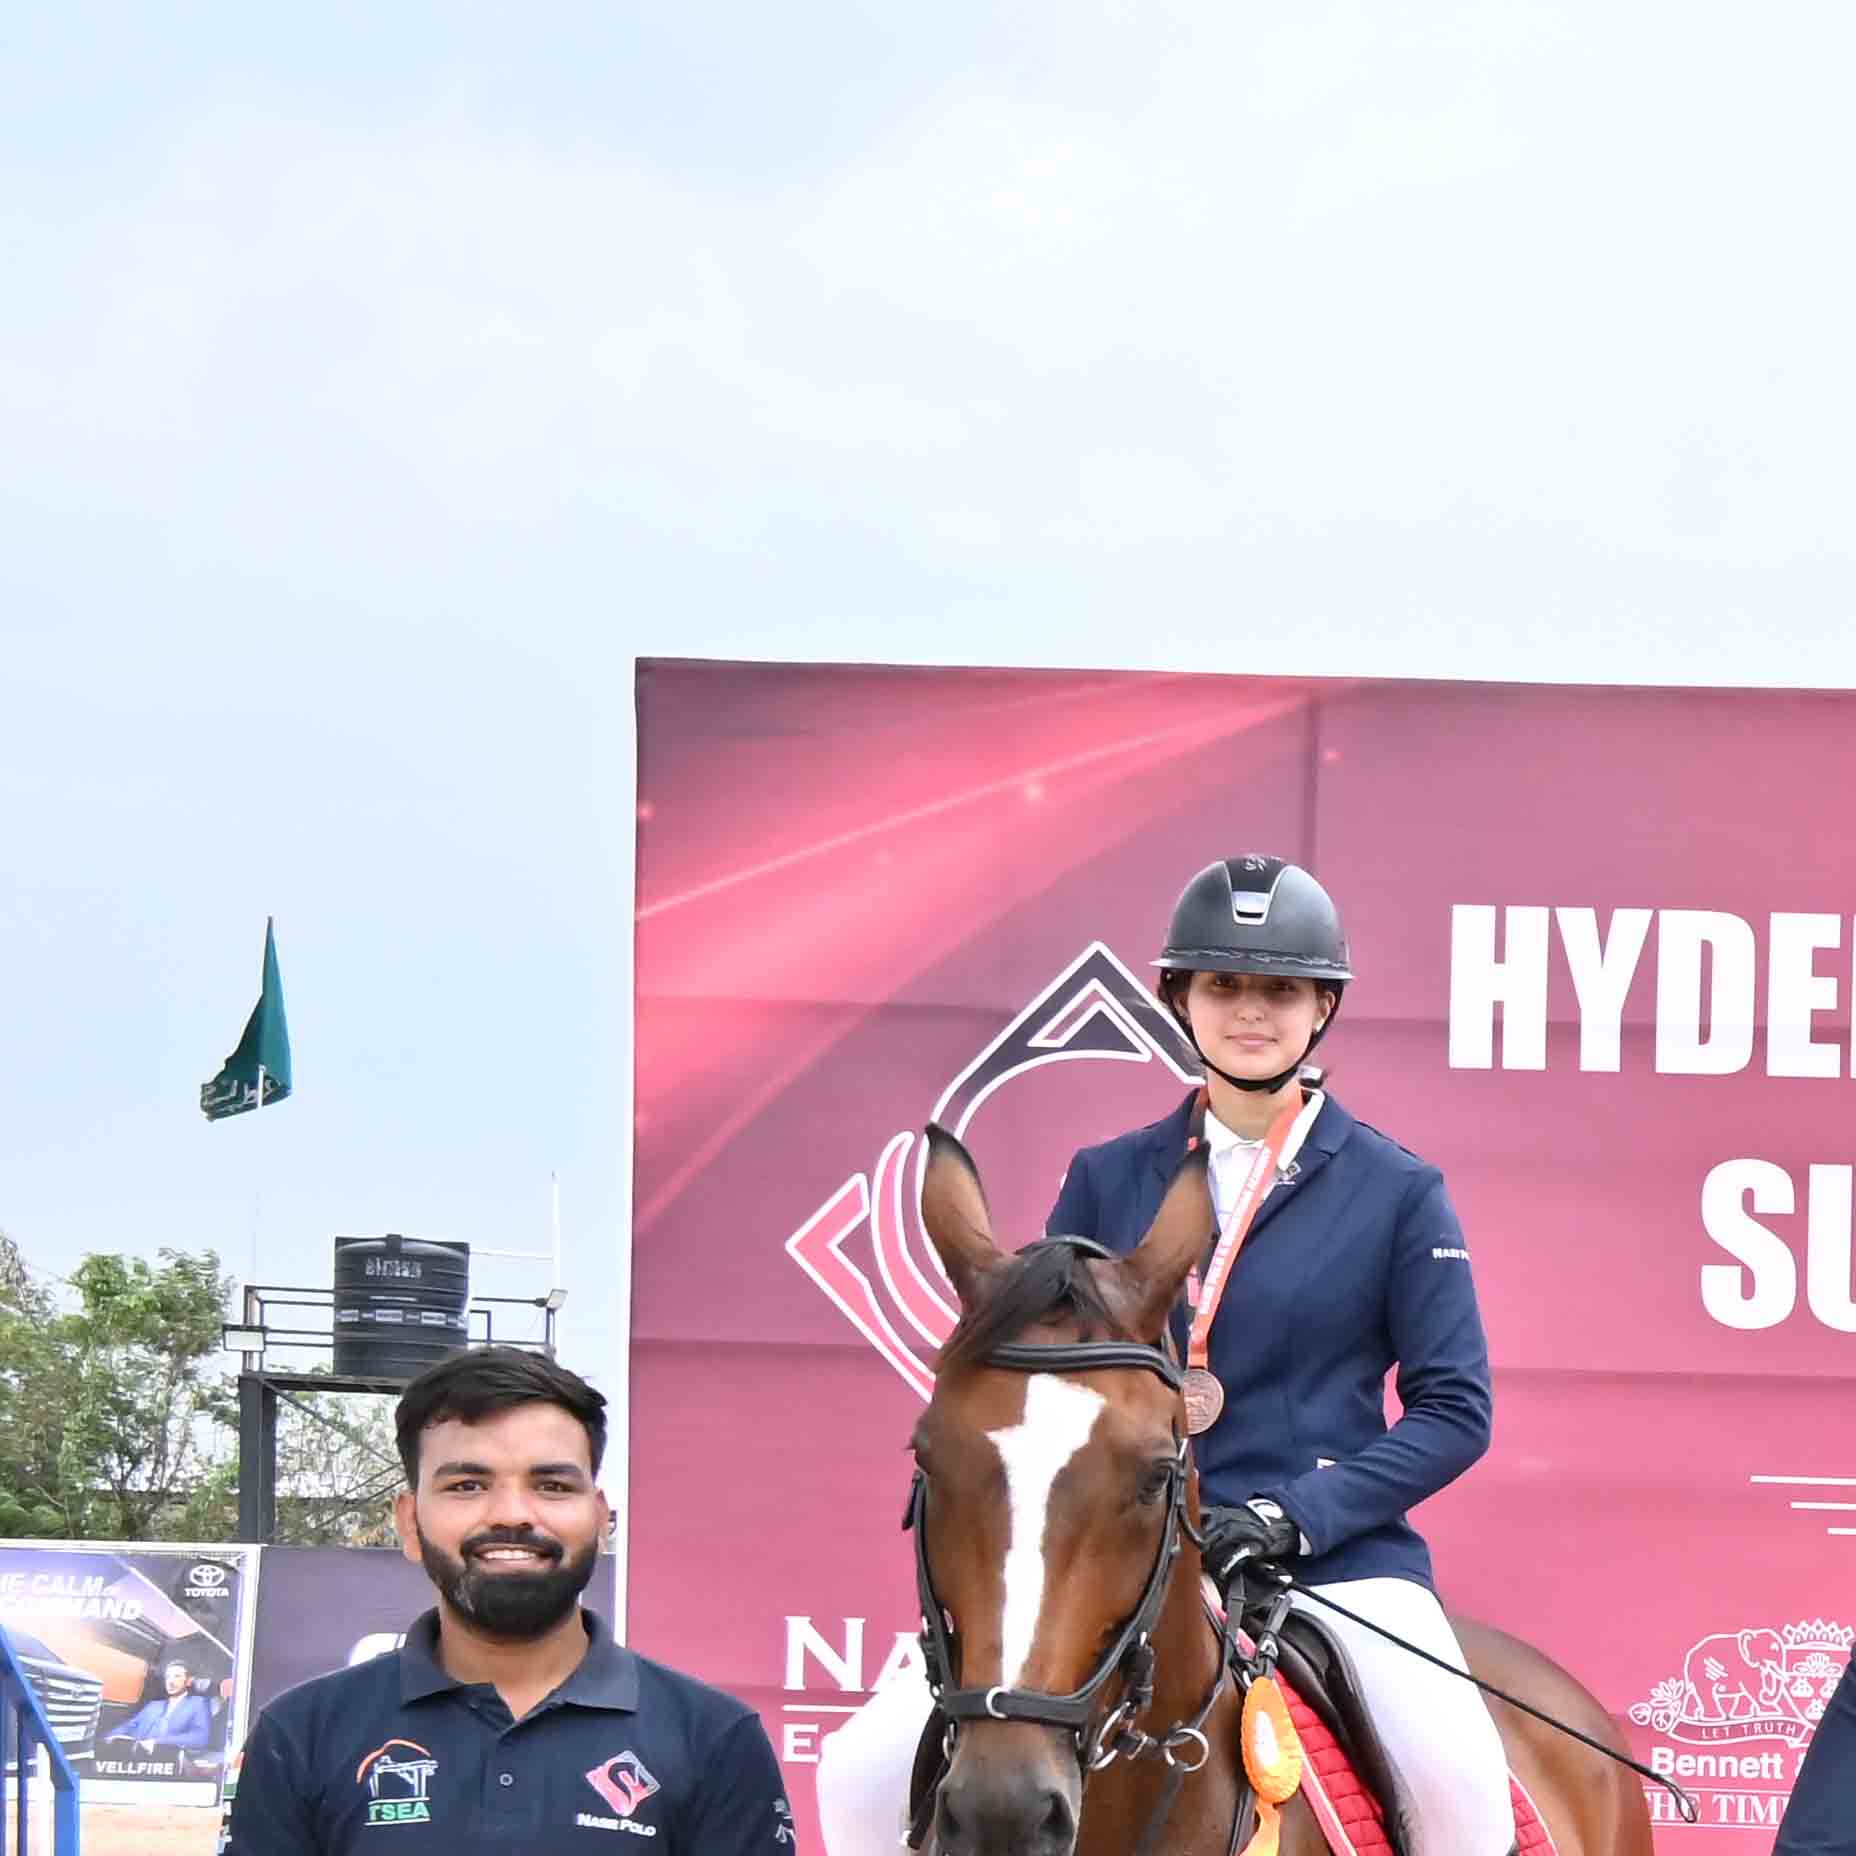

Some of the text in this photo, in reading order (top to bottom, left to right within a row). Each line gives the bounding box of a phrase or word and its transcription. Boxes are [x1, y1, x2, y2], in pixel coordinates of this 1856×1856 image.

[184, 1587, 229, 1598] TOYOTA
[1702, 1721, 1797, 1740] LET TRUTH
[96, 1761, 175, 1776] VELLFIRE
[1651, 1747, 1784, 1780] Bennett
[1712, 1793, 1792, 1824] TIM
